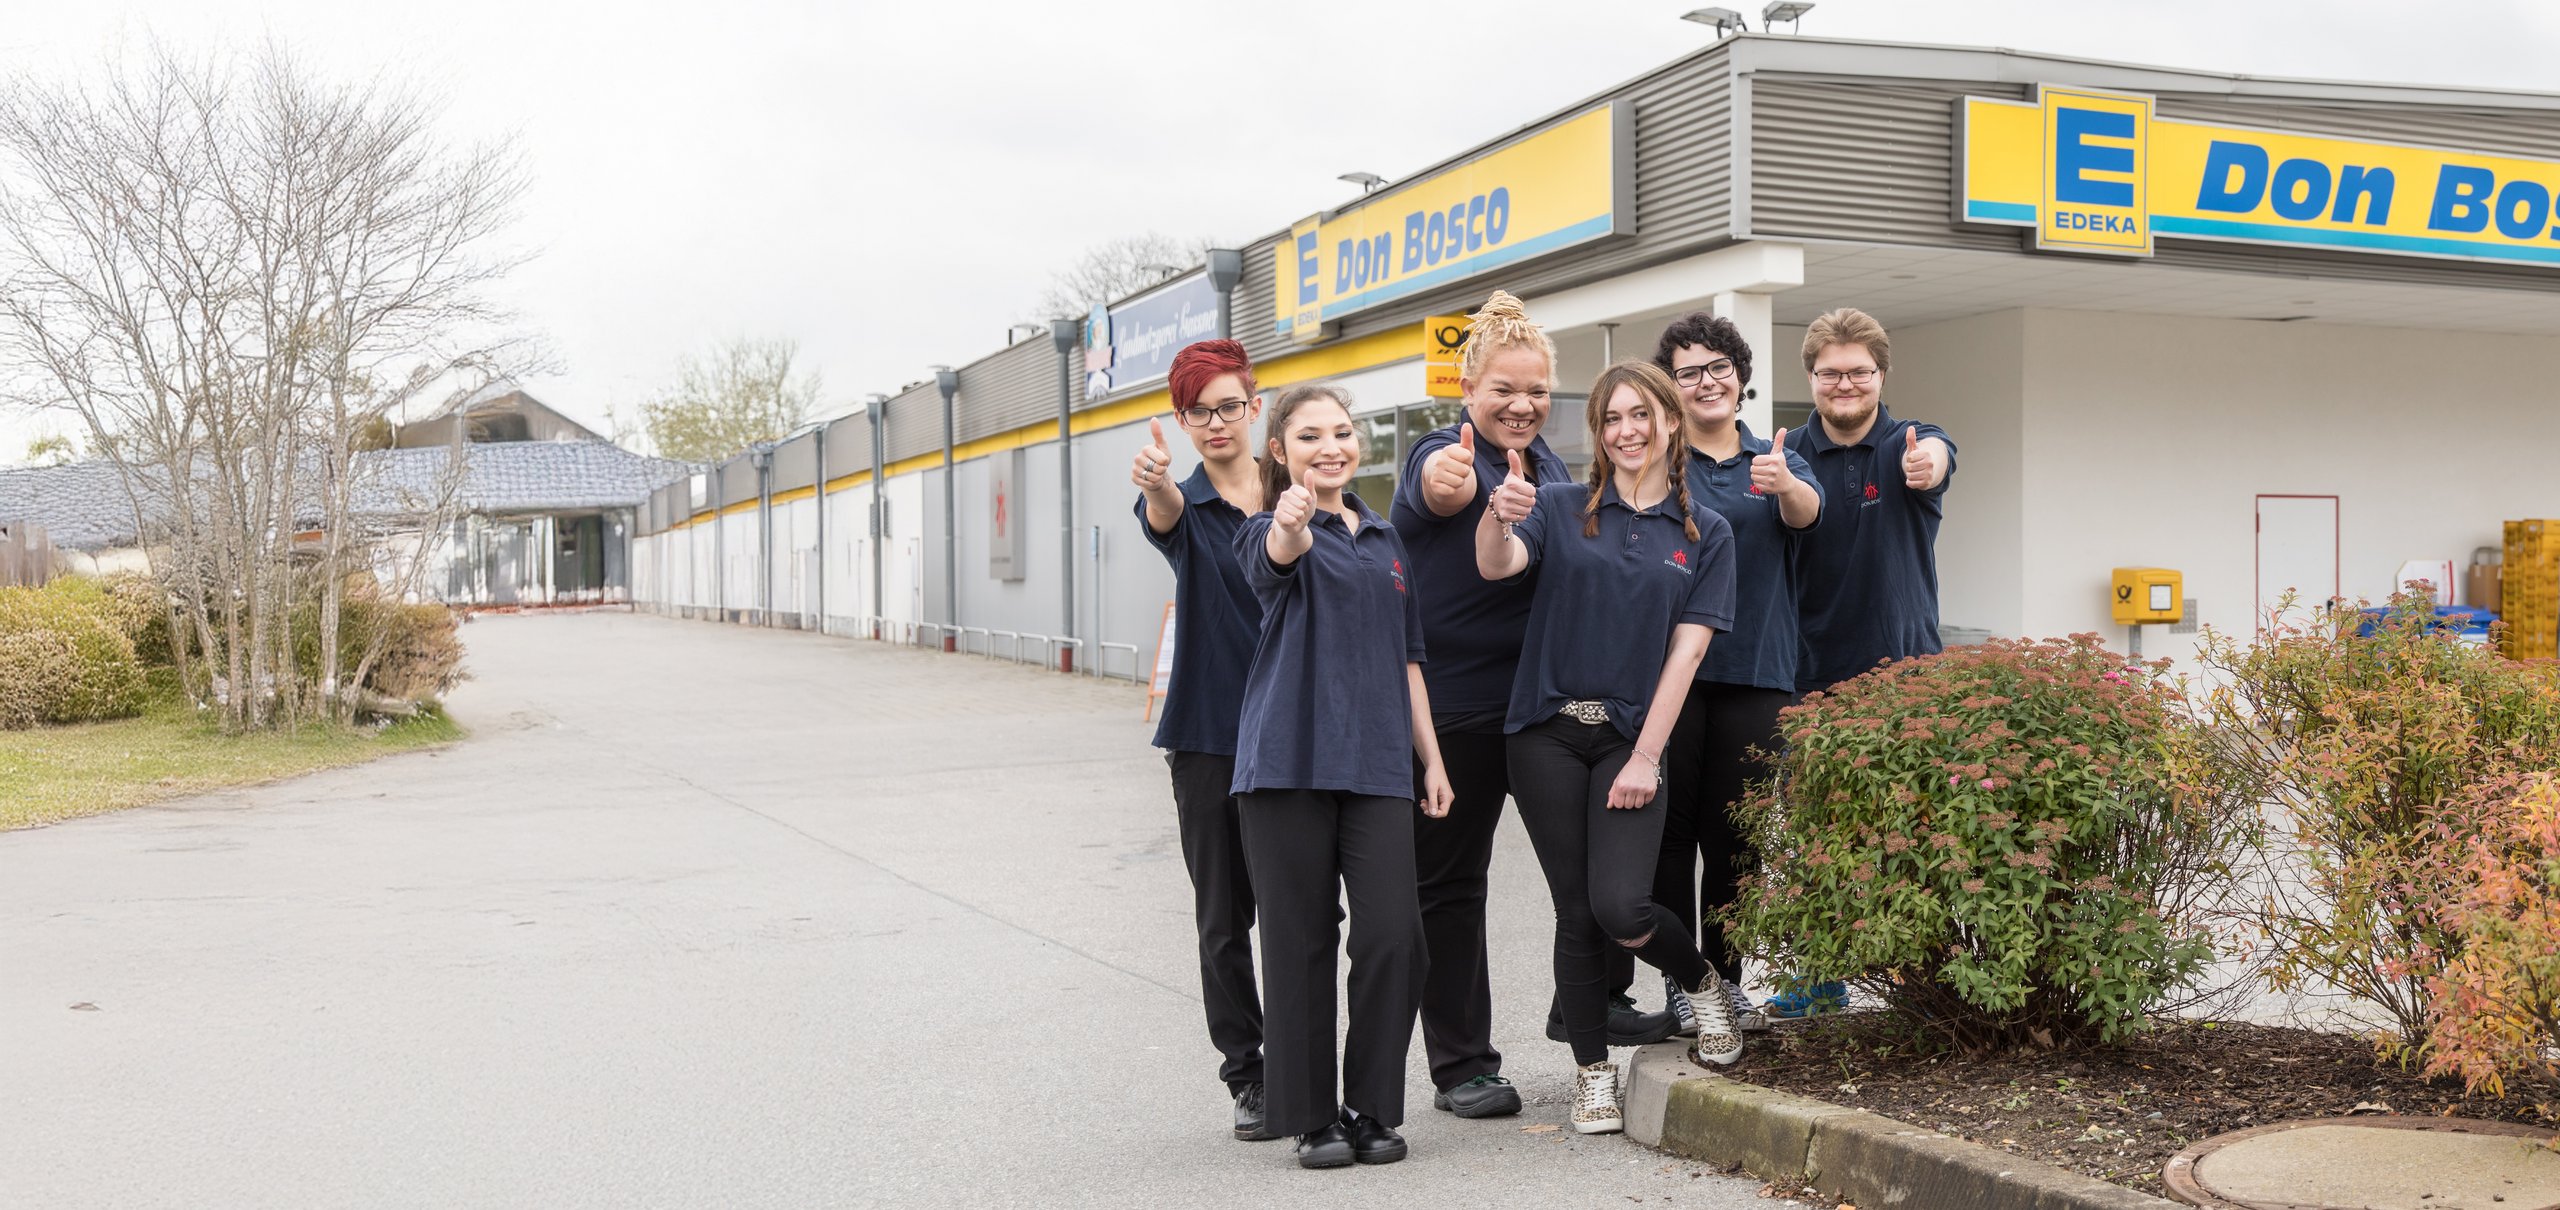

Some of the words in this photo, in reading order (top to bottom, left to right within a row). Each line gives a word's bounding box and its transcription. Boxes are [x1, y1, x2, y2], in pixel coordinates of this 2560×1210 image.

[2055, 106, 2135, 207] E
[2195, 139, 2396, 226] Don
[2427, 163, 2560, 241] Bo
[2055, 211, 2136, 234] EDEKA
[1297, 230, 1319, 306] E
[1335, 231, 1392, 295] Don
[1435, 376, 1461, 385] DH
[1664, 559, 1677, 568] DON
[1677, 564, 1692, 575] BOSCO
